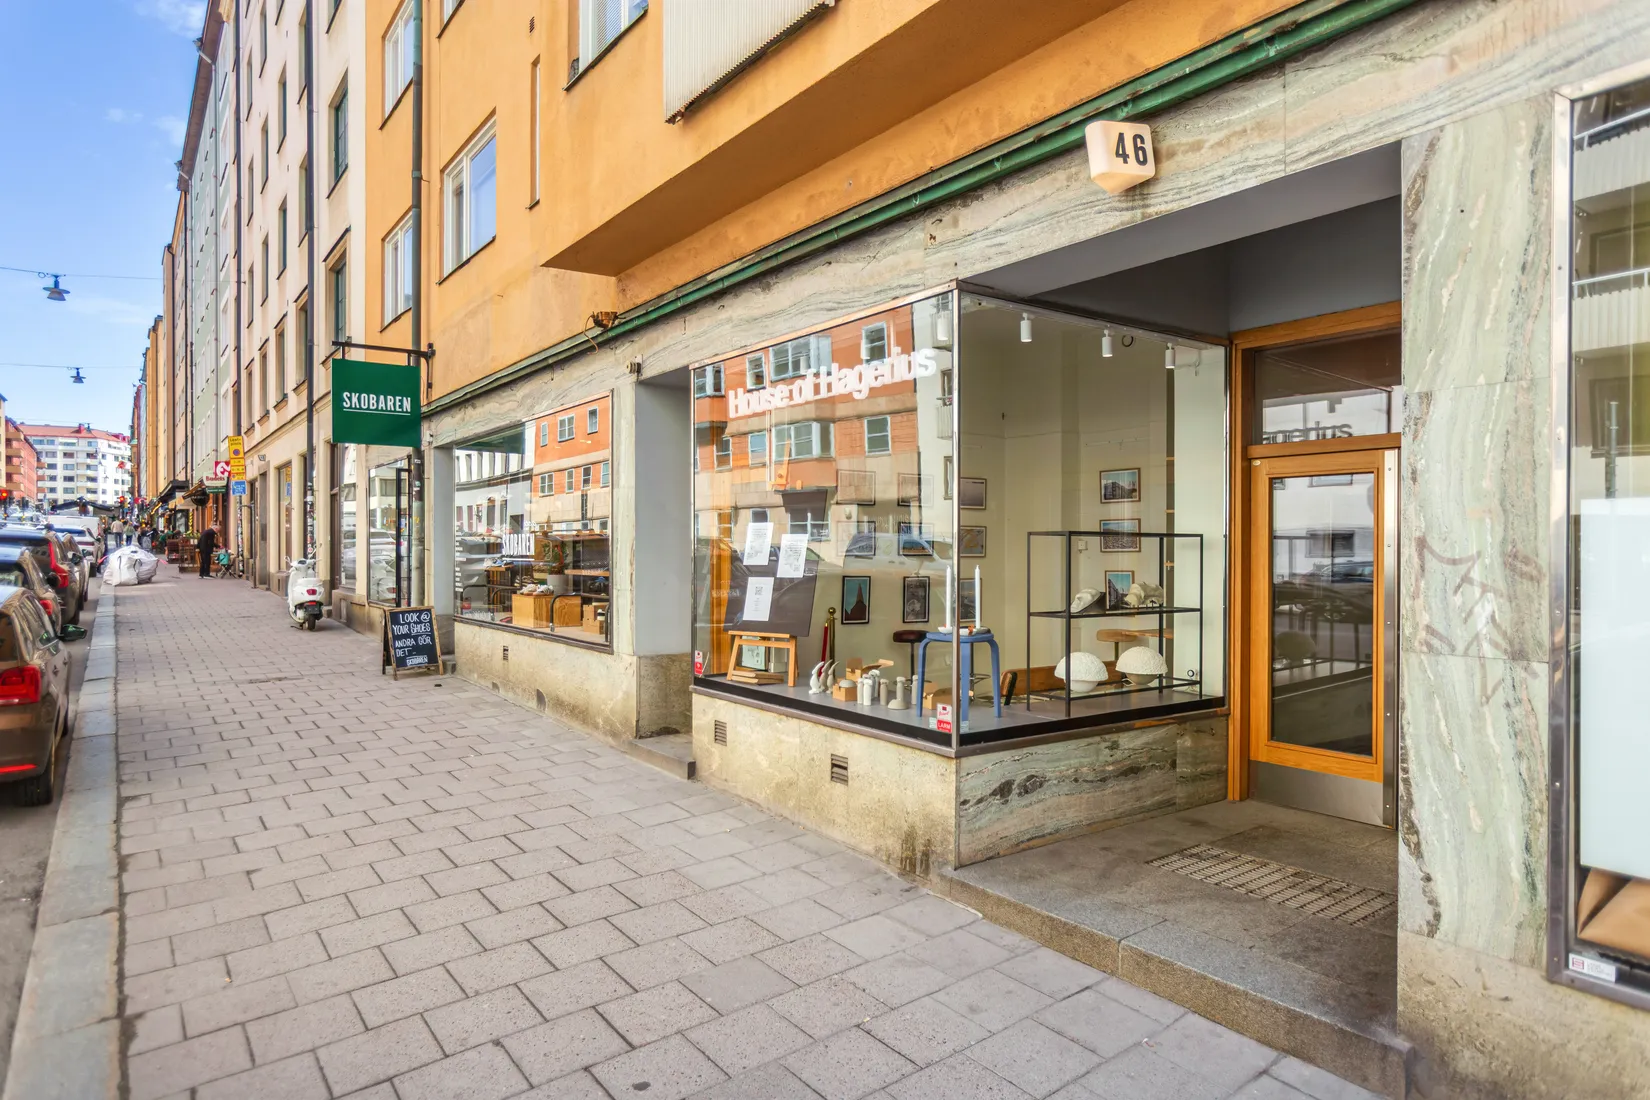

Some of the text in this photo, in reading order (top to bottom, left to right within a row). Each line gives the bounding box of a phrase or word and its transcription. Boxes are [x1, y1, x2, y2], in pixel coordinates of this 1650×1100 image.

[1115, 132, 1148, 167] 46
[728, 347, 937, 419] House of Hagelius
[342, 391, 411, 413] SKOBAREN
[502, 533, 535, 556] SKOBAREN
[400, 611, 430, 623] LOOK @
[392, 623, 431, 635] YOUR SHOES
[396, 635, 432, 647] ANDRA GÖR
